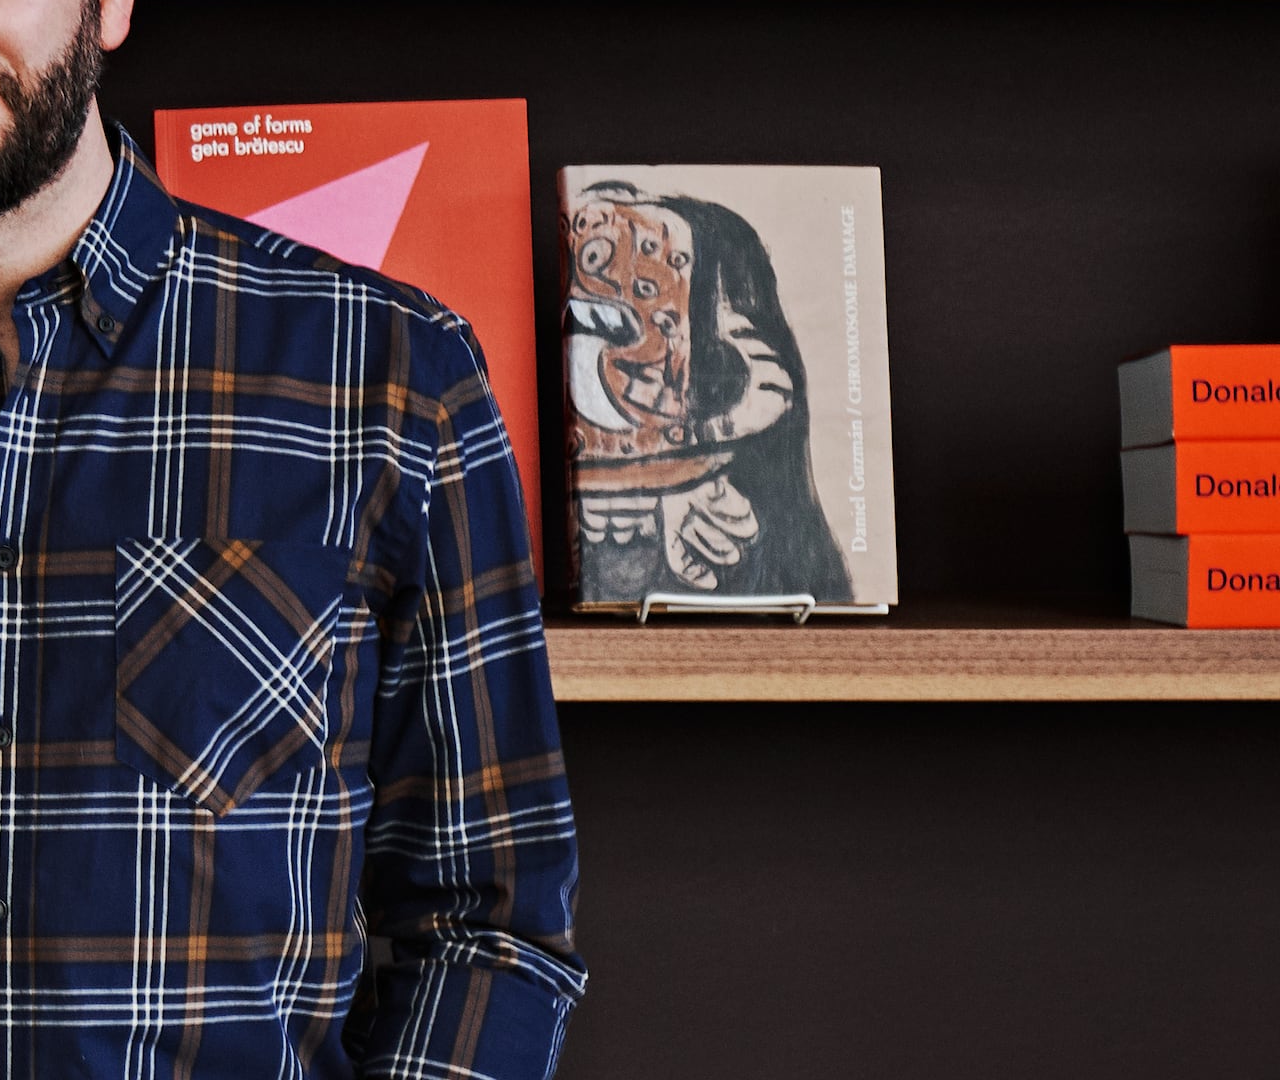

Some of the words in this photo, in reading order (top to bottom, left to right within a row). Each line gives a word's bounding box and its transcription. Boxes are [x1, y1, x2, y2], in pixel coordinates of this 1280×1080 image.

[190, 122, 238, 142] game
[243, 114, 261, 135] of
[265, 113, 313, 135] forms
[191, 140, 229, 163] geta
[843, 204, 858, 276] DAMAGE
[845, 278, 863, 405] CHROMOSOME
[848, 420, 866, 492] Guzmán
[1195, 474, 1280, 498] Donal
[850, 495, 868, 554] Daniel
